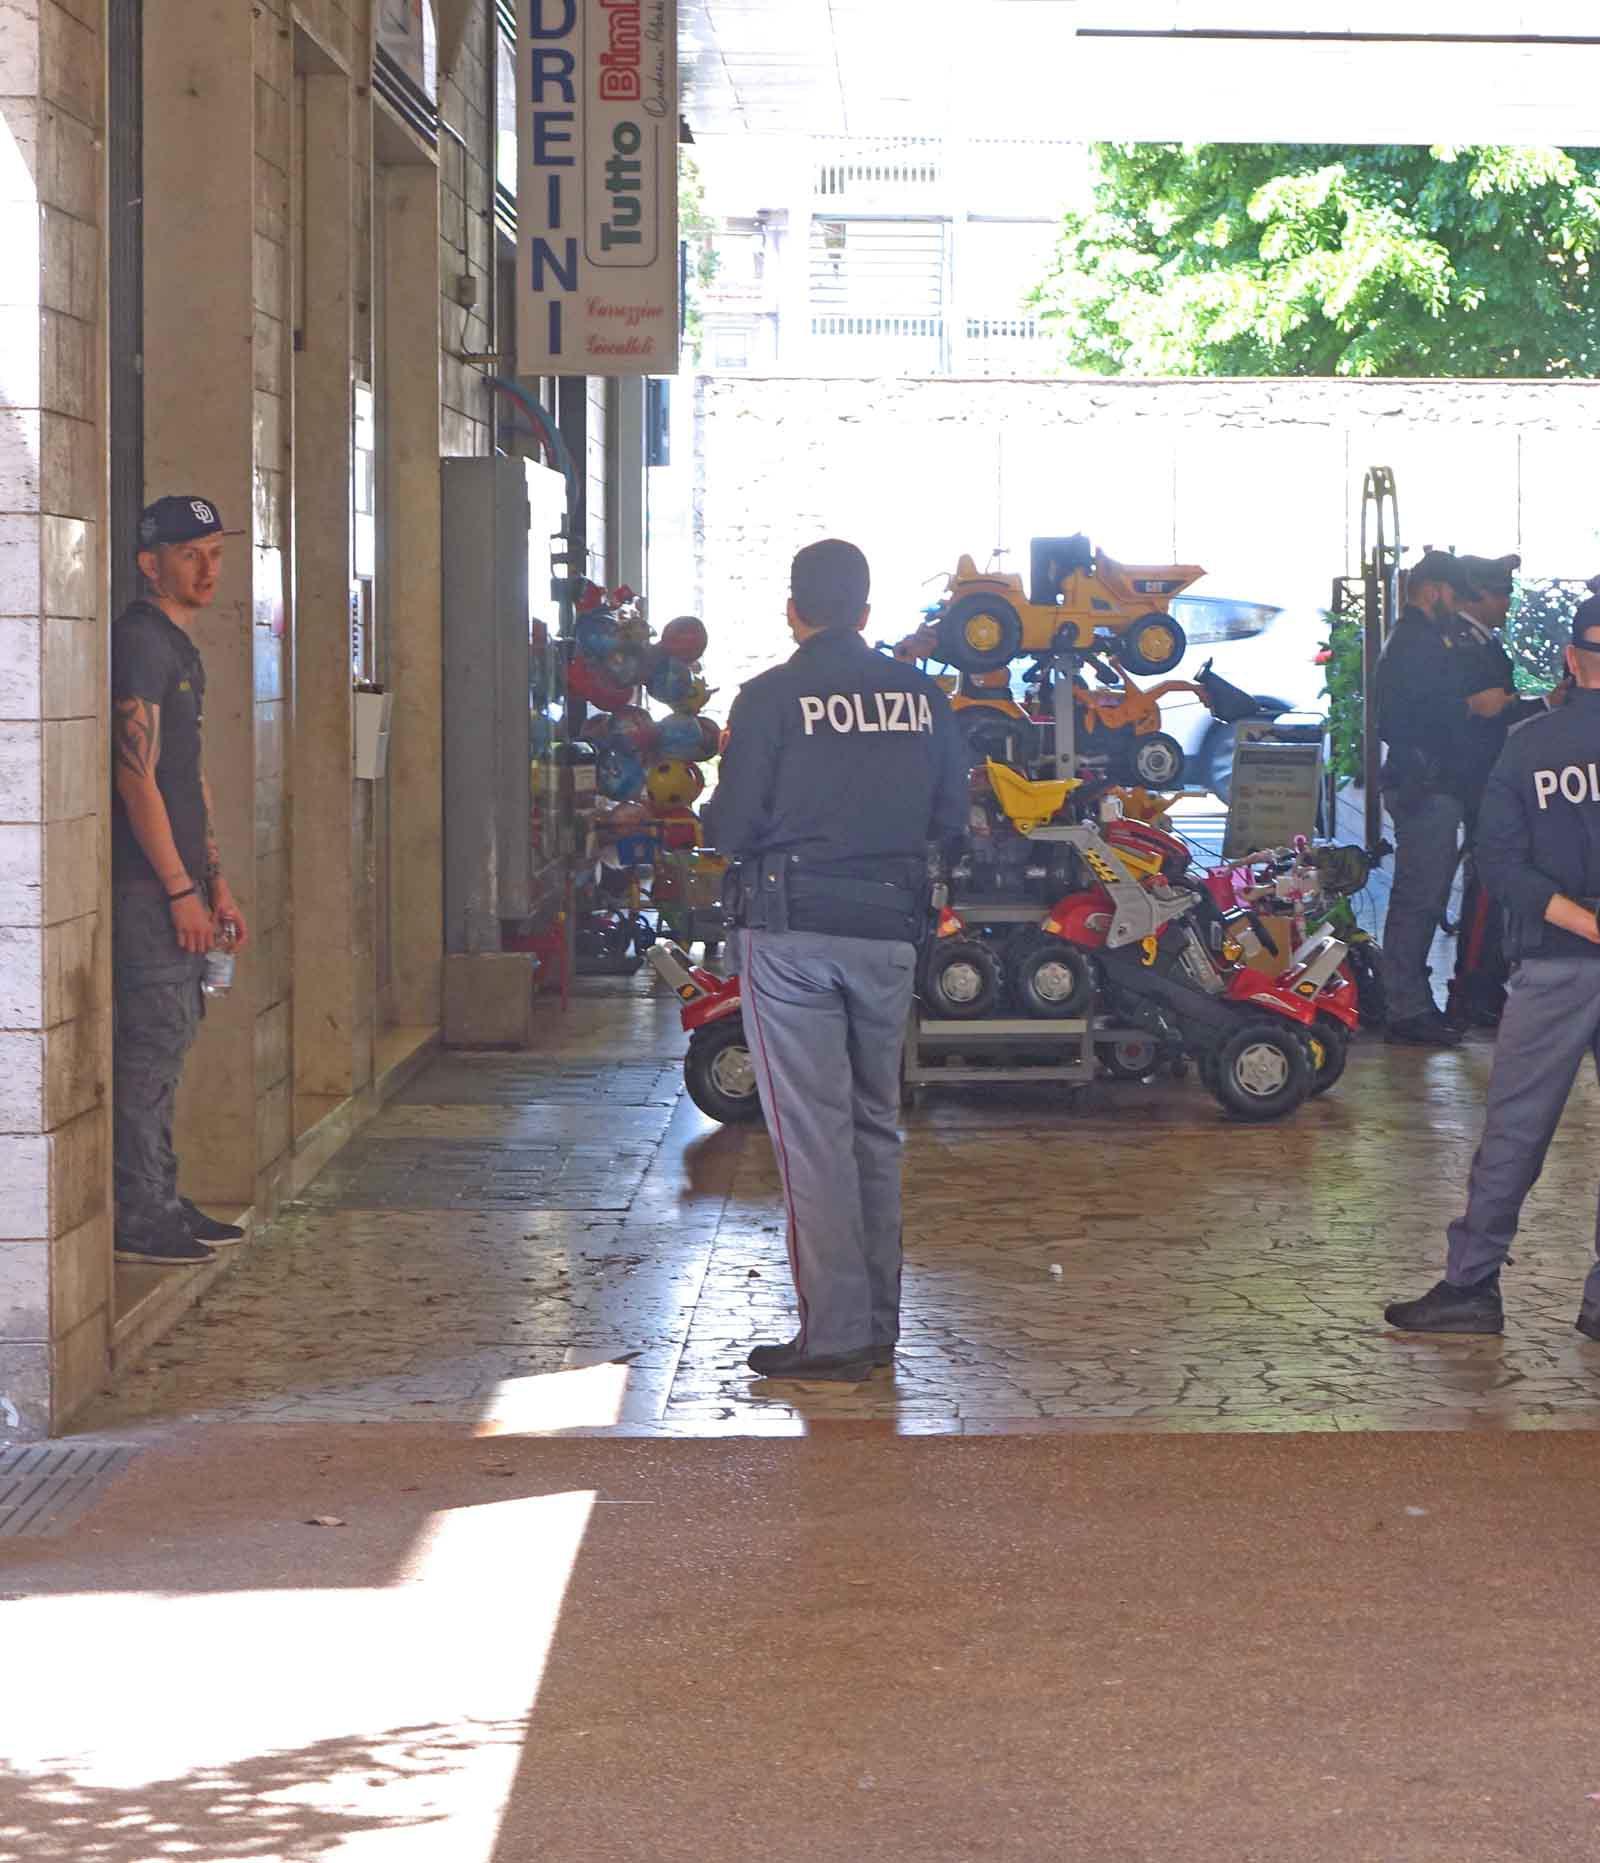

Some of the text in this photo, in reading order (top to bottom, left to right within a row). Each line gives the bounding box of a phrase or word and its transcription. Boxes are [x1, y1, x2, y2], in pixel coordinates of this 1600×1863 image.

[600, 0, 641, 251] Tutto Bim
[799, 692, 934, 736] POLIZIA
